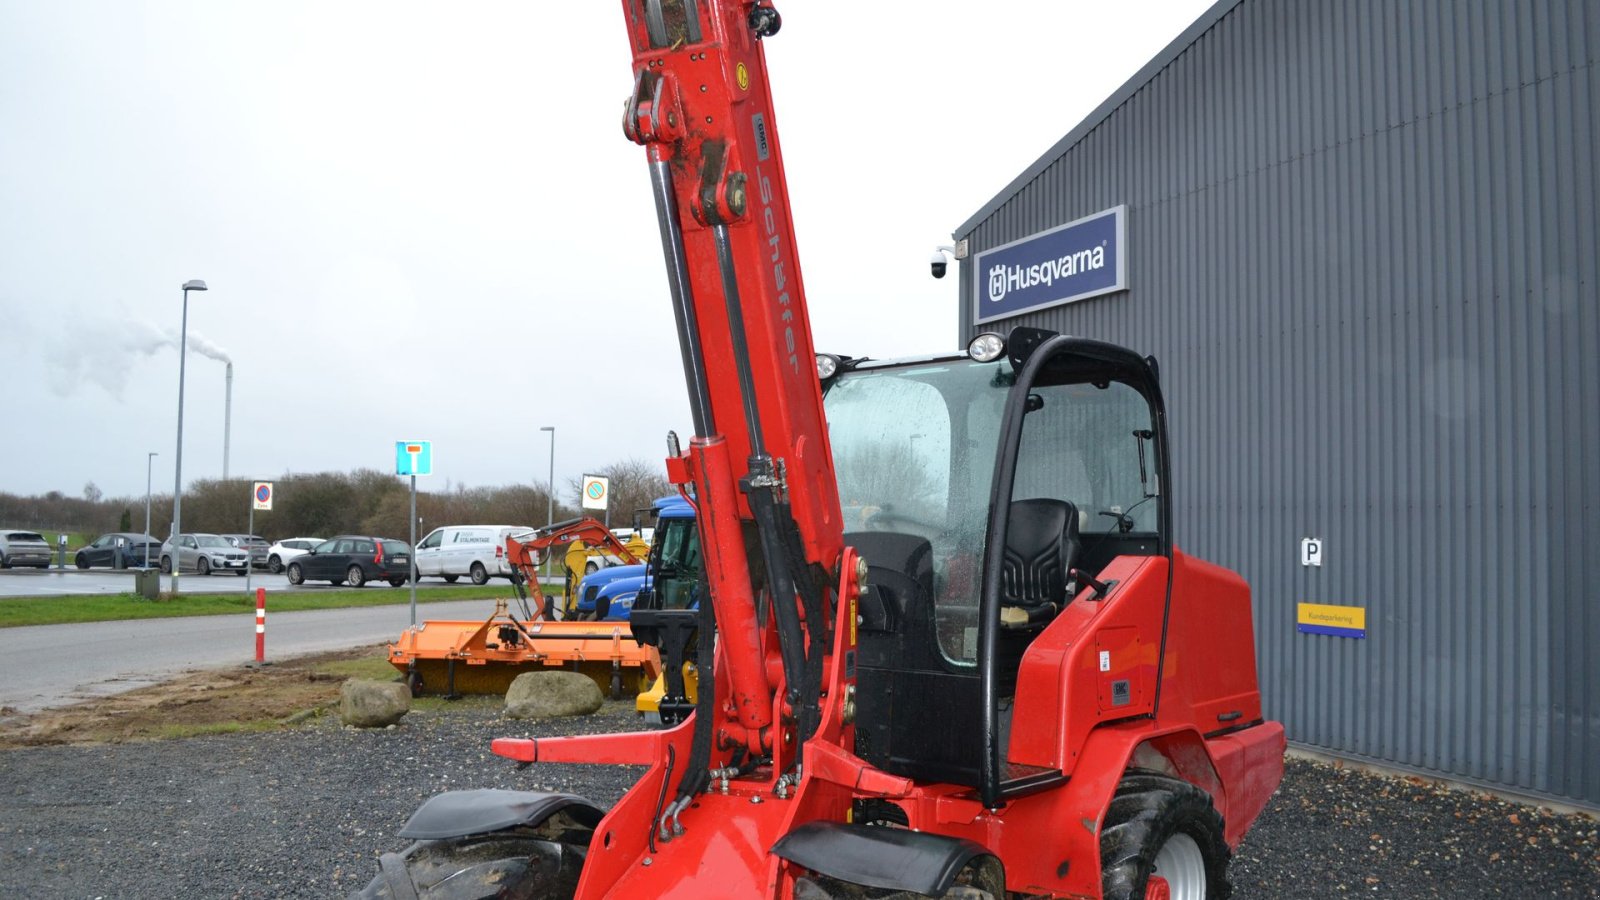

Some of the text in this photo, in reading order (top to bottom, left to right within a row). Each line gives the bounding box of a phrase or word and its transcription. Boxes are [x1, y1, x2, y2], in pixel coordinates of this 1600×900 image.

[757, 167, 800, 374] Schäffer
[1007, 245, 1105, 292] Husqvarna
[1307, 543, 1318, 560] P
